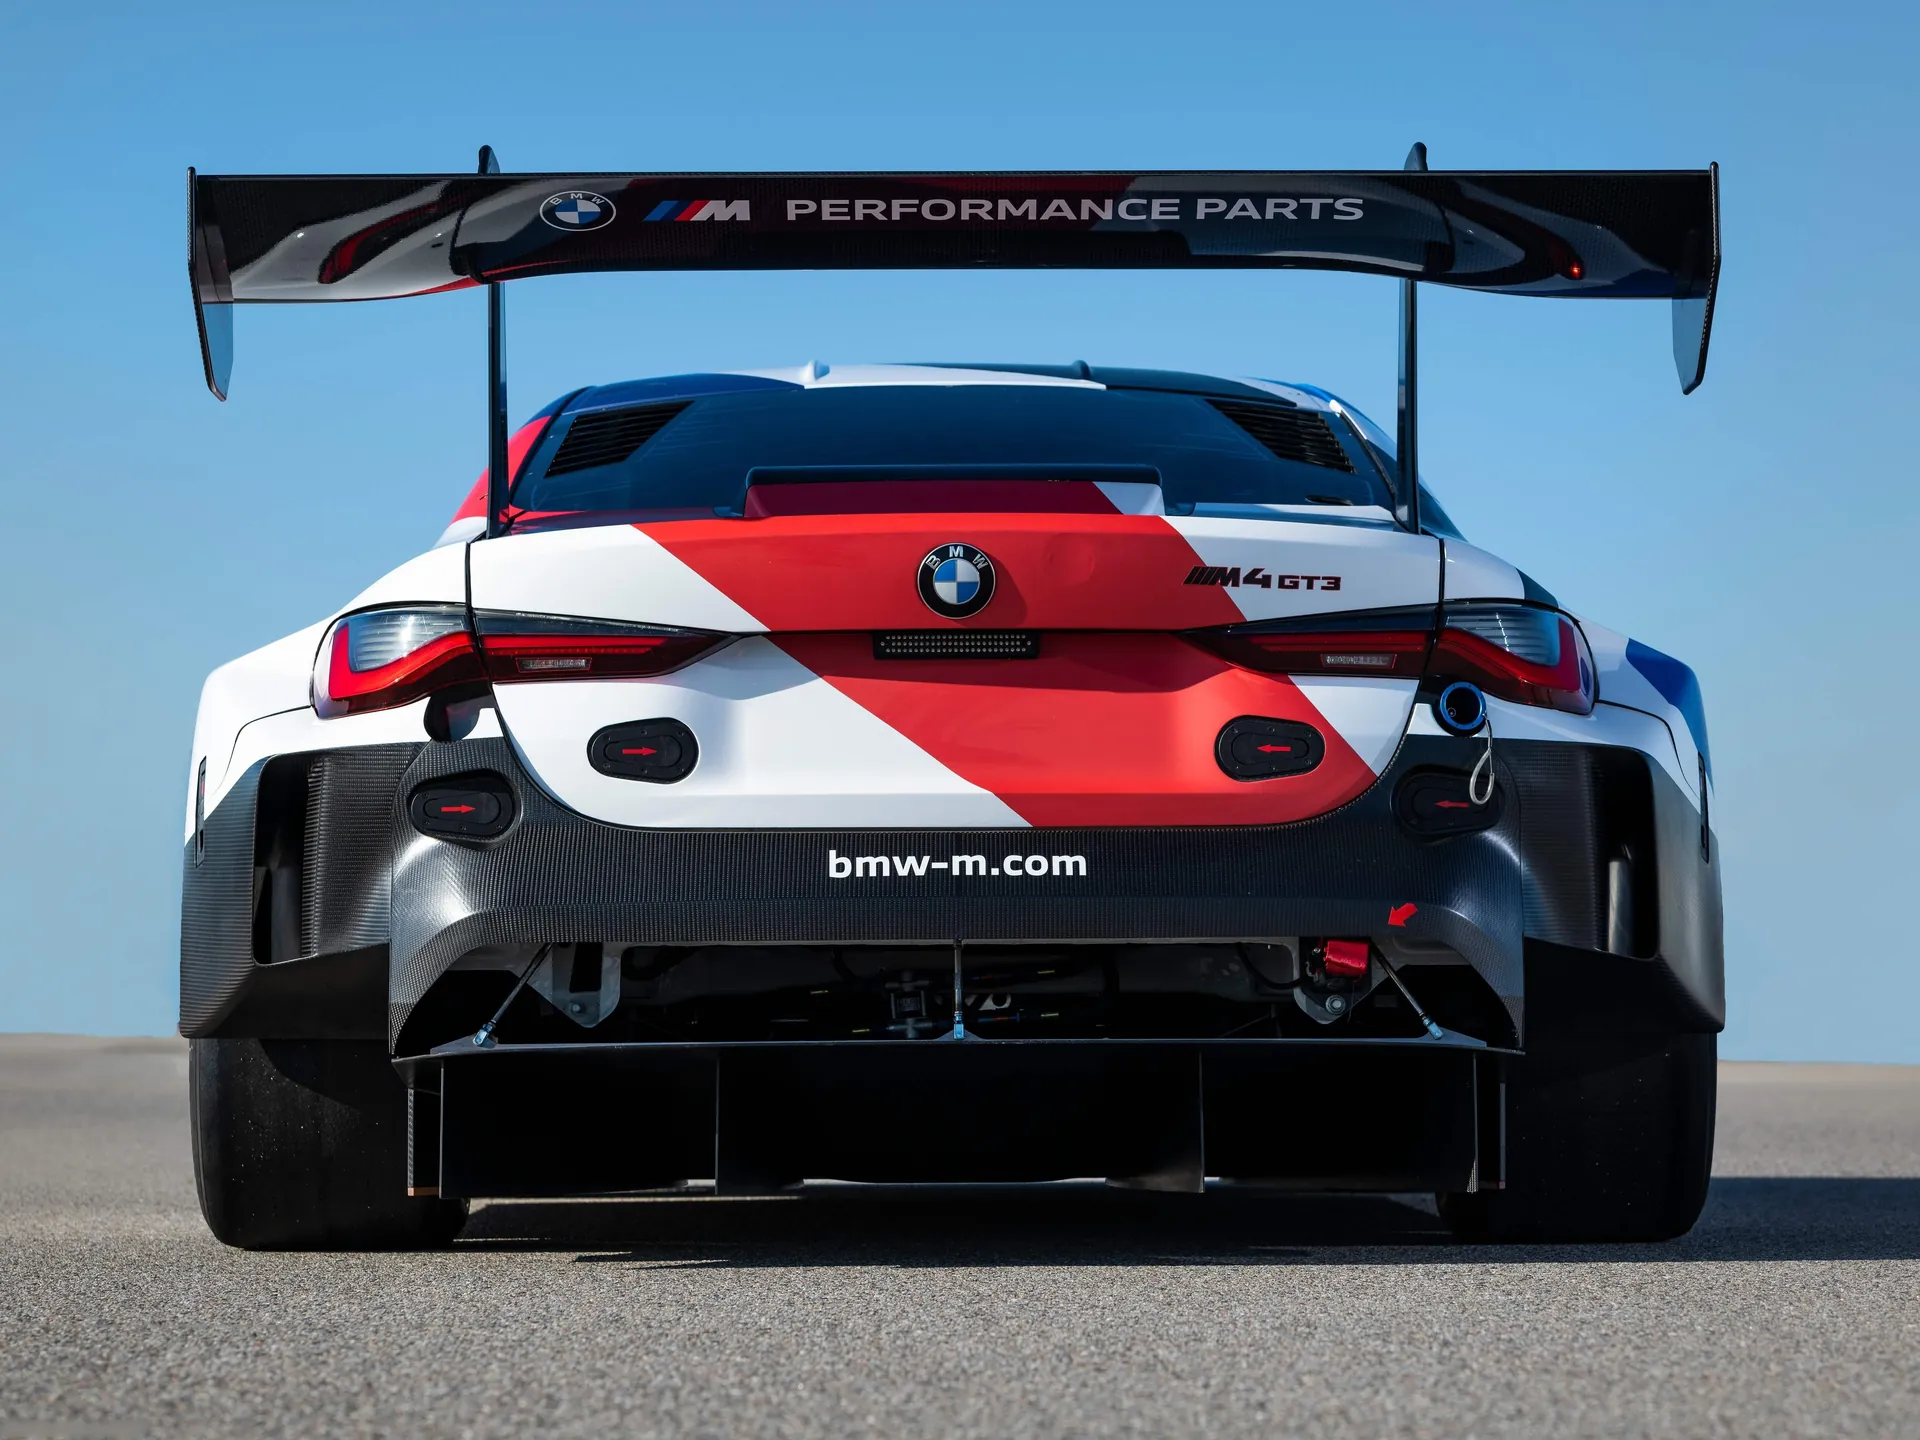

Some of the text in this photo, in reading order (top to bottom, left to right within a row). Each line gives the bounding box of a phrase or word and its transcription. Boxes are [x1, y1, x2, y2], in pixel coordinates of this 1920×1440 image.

[549, 192, 605, 206] BMW
[787, 198, 1180, 221] PERFORMANCE
[1196, 198, 1364, 221] PARTS
[925, 545, 989, 570] BMW
[1277, 574, 1342, 591] GT3
[828, 849, 1087, 879] bmw-m.com
